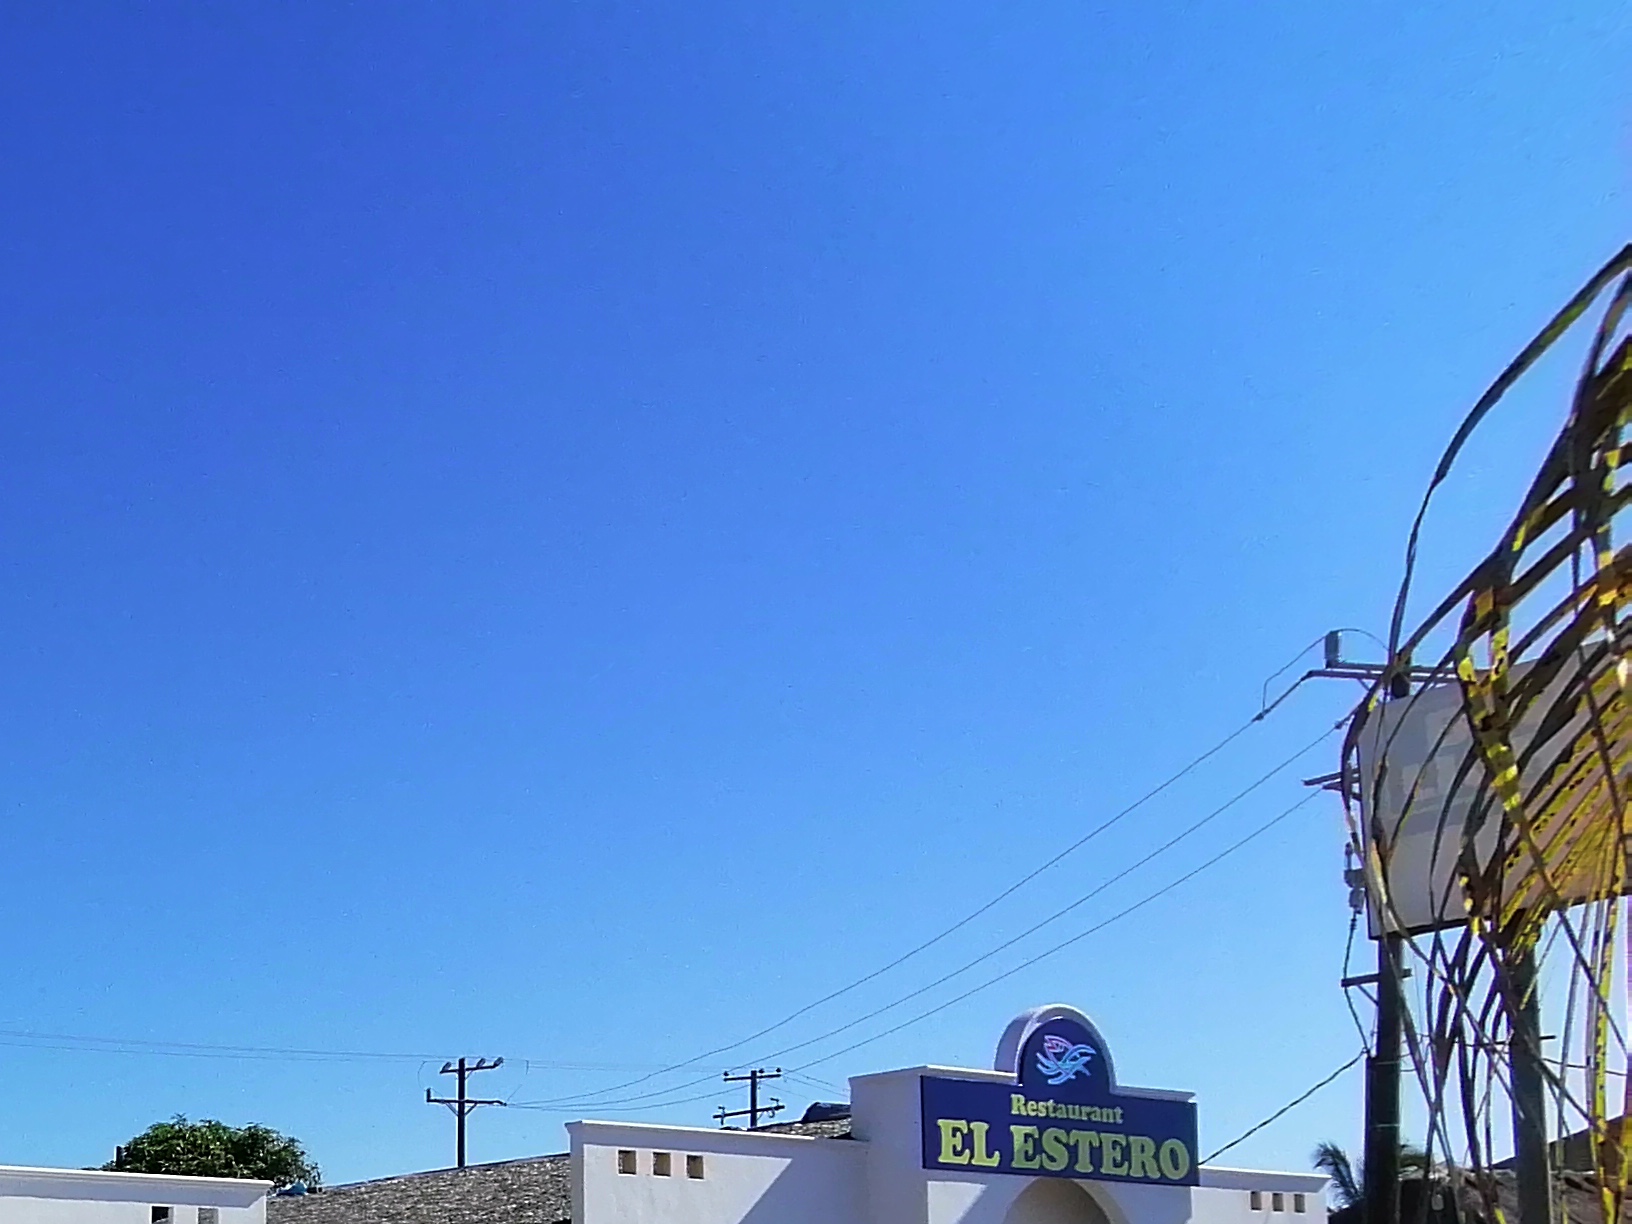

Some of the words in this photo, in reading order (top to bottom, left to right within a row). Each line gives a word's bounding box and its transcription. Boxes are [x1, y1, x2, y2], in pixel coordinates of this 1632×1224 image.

[1011, 1094, 1124, 1123] Restaurant
[937, 1119, 1000, 1167] EL
[1011, 1125, 1189, 1180] ESTERO
